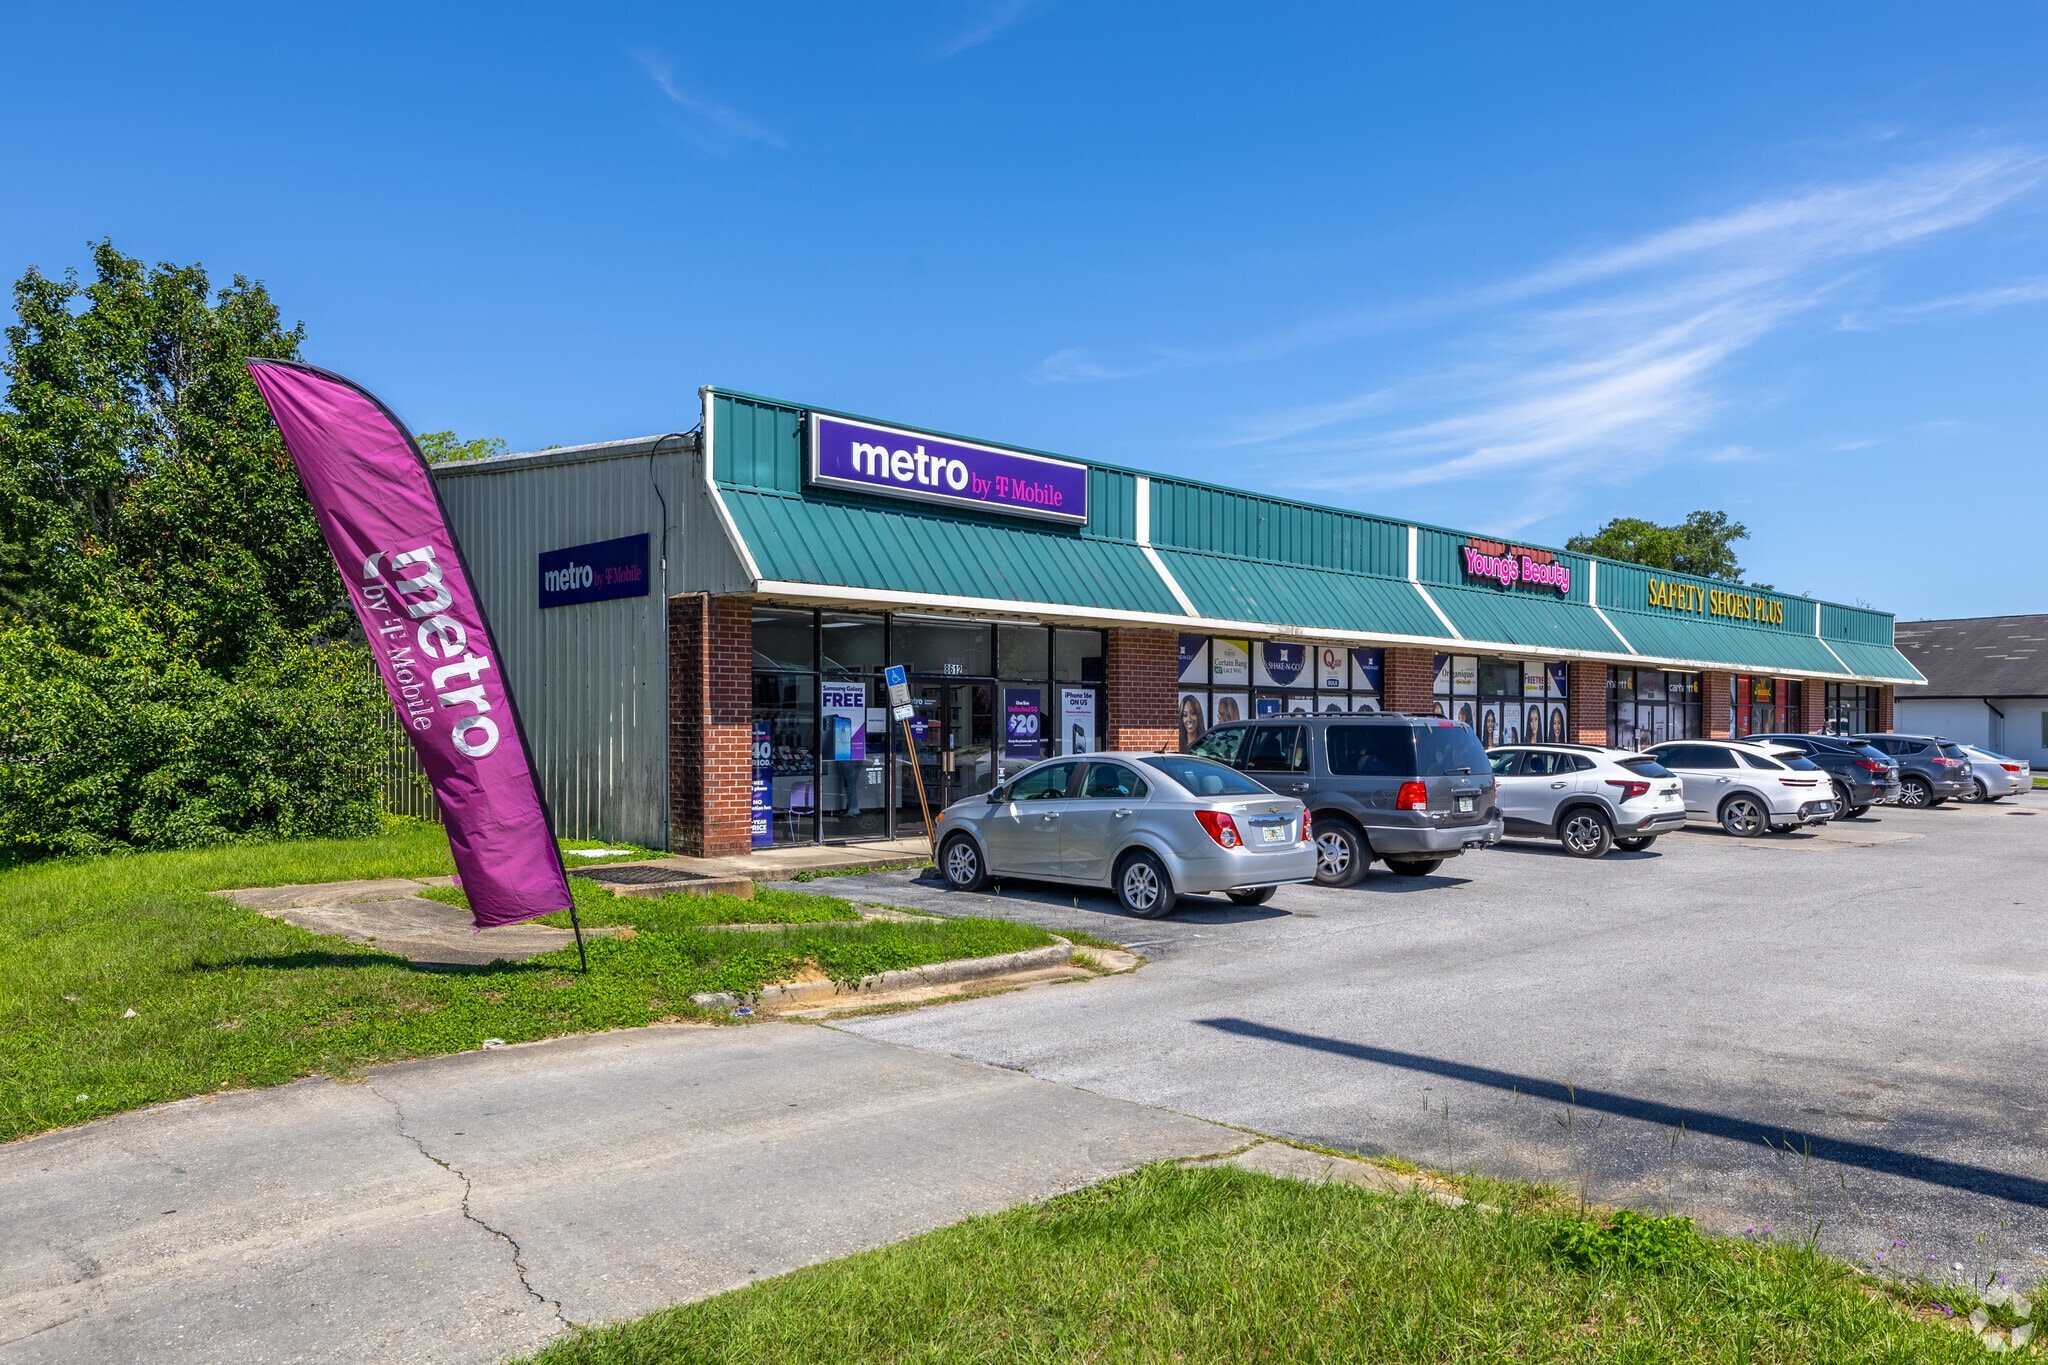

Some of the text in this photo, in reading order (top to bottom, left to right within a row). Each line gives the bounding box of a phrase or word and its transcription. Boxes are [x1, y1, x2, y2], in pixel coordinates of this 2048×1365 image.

[851, 441, 969, 491] metro
[971, 472, 992, 500] by
[544, 562, 593, 592] metro
[594, 570, 604, 590] by
[1464, 546, 1570, 593] Young's Beauty
[360, 582, 391, 613] by
[1648, 578, 1783, 624] SAFETY SHOES PLUS
[391, 545, 500, 758] metro
[944, 664, 963, 675] 8612
[1214, 658, 1247, 669] Curtain Bang
[1268, 661, 1300, 671] SHAKE-N-GO
[1442, 668, 1474, 680] Oranique
[823, 692, 863, 707] FREE
[1010, 714, 1038, 733] $20
[752, 742, 771, 759] 40
